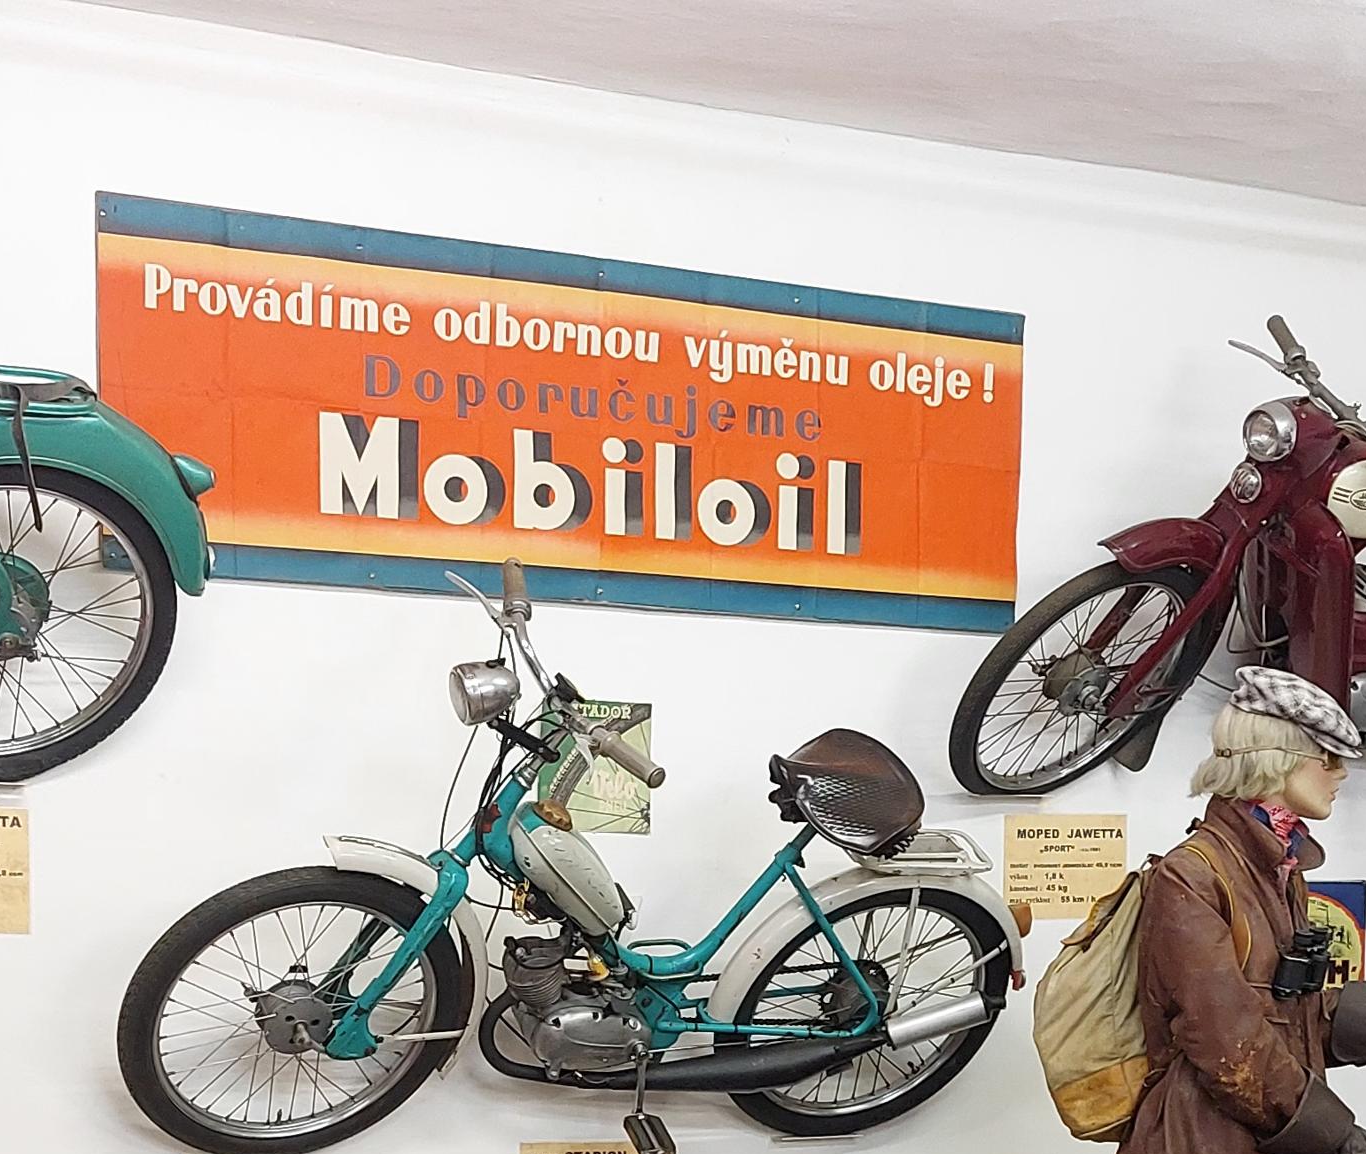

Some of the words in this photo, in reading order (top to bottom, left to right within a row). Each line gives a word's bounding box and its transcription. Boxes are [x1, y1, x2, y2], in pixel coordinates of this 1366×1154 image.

[144, 262, 410, 336] Provádíme
[435, 302, 659, 363] odbornou
[685, 328, 849, 387] výměnu
[869, 356, 969, 406] oleje
[364, 354, 822, 442] Doporučujeme
[318, 409, 862, 555] Mobiloil
[572, 704, 632, 719] TADOR
[1017, 829, 1059, 838] MOPED
[1067, 829, 1123, 838] JAWETTA
